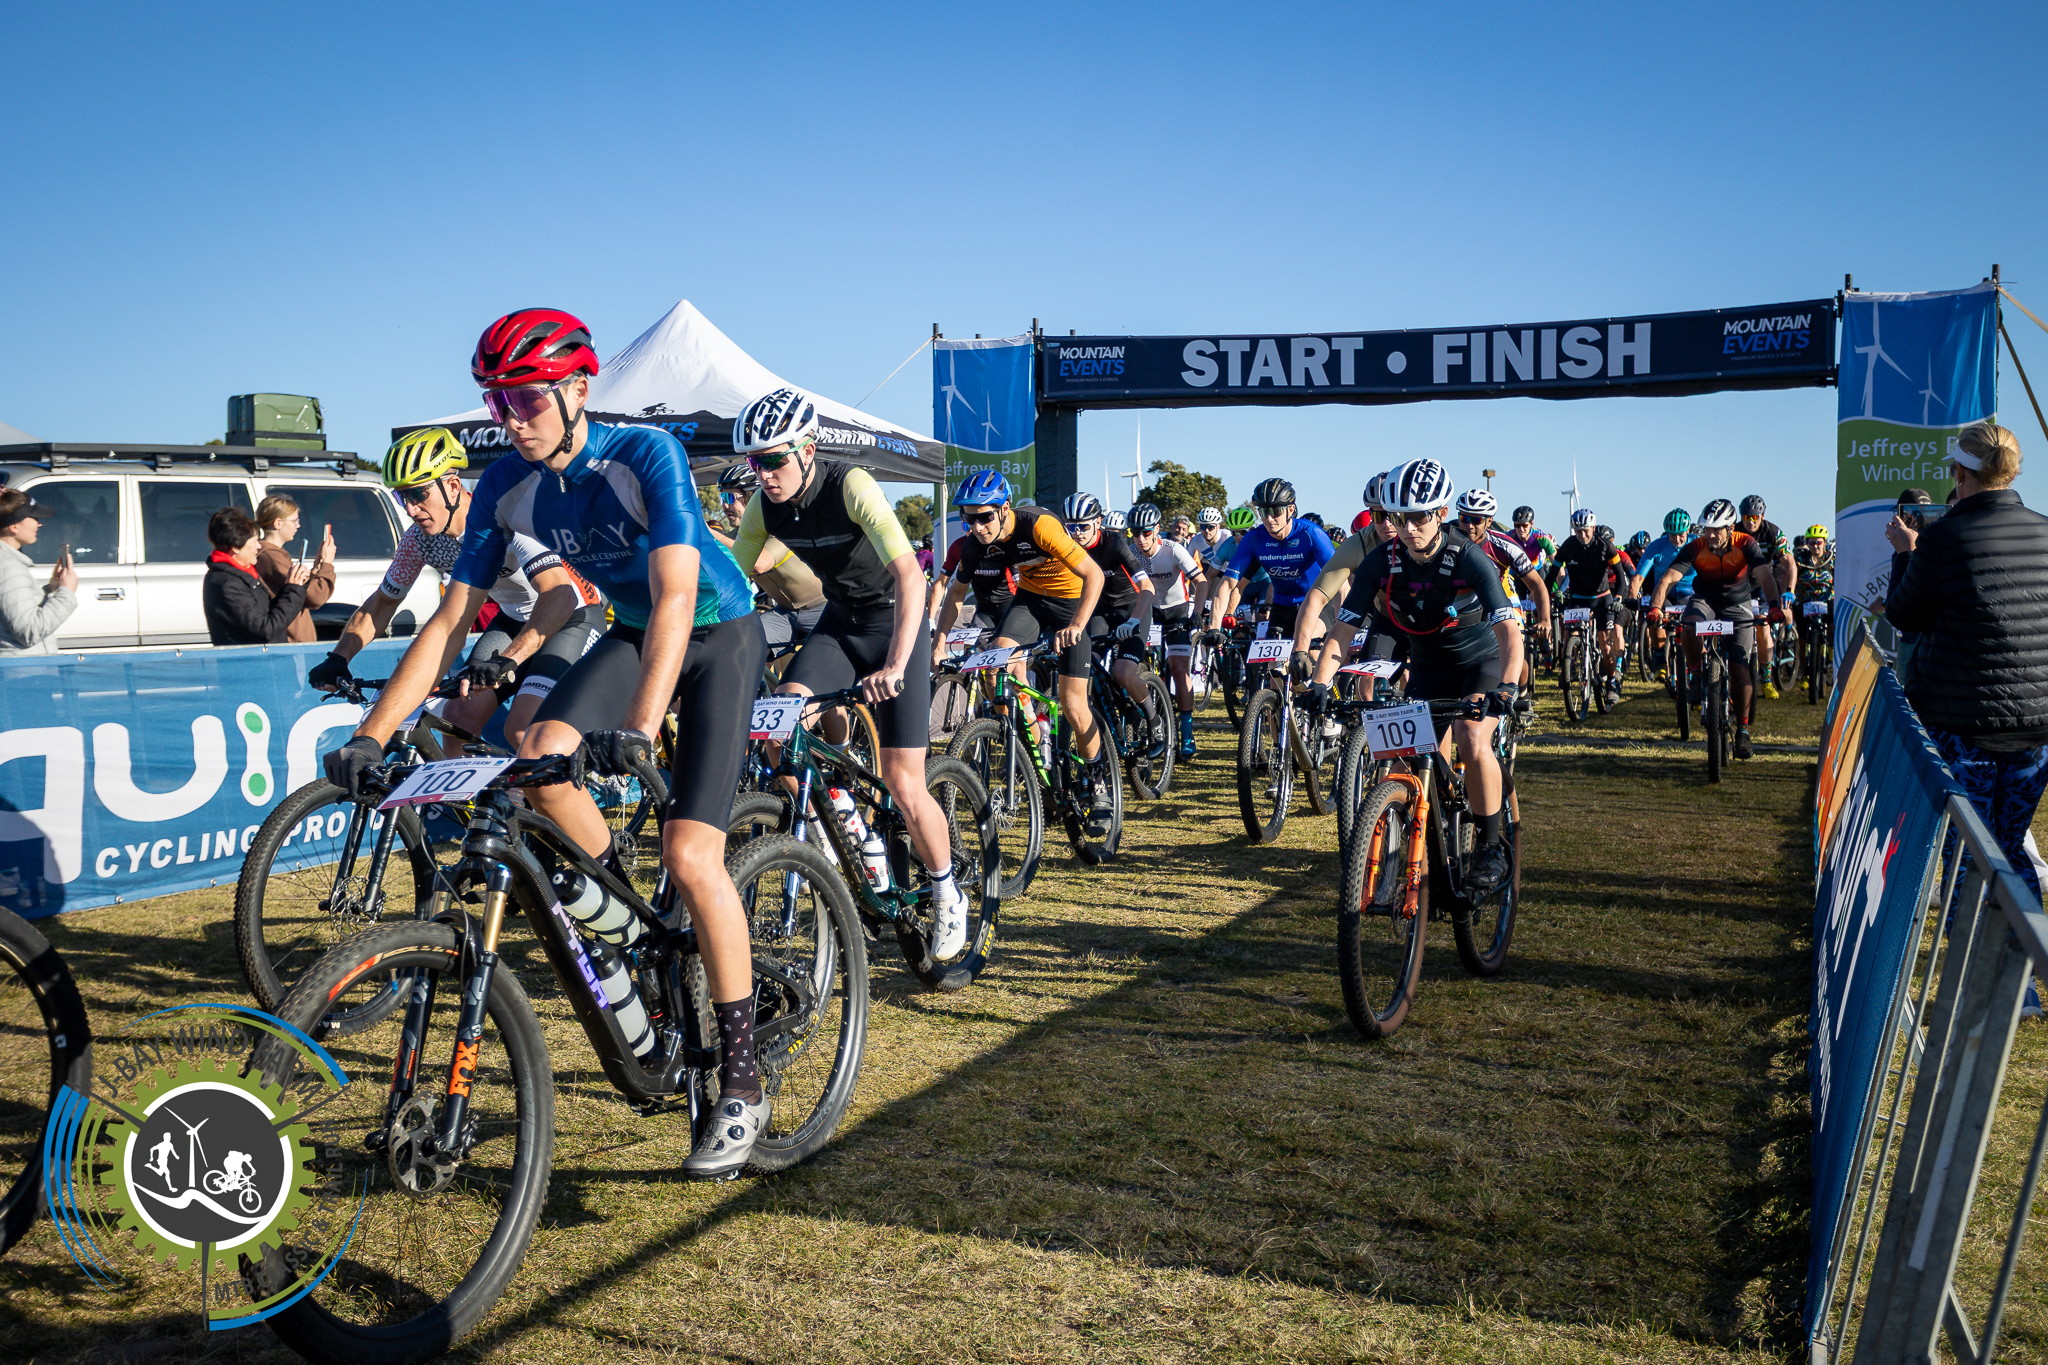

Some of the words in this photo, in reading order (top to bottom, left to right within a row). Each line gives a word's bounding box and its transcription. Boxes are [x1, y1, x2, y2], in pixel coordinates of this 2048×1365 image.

[1723, 313, 1812, 336] MOUNTAIN
[1722, 329, 1811, 354] EVENTS
[1059, 345, 1126, 360] MOUNTAIN
[1180, 337, 1364, 387] START
[1433, 322, 1652, 384] FINISH
[1059, 359, 1126, 377] EVENTS
[1847, 437, 1938, 460] Jeffreys
[433, 450, 453, 469] SCOTT
[1001, 460, 1030, 478] Bay
[1861, 462, 1915, 482] Wind
[568, 553, 598, 564] CYCLE
[598, 549, 635, 561] CENTRE
[1268, 566, 1300, 577] Ford
[1569, 611, 1584, 620] 123
[1707, 622, 1723, 632] 43
[976, 653, 998, 666] 36
[1258, 645, 1283, 657] 130
[751, 708, 784, 730] 33
[1377, 719, 1417, 749] 109
[410, 769, 477, 797] 100
[448, 1041, 480, 1098] FOX
